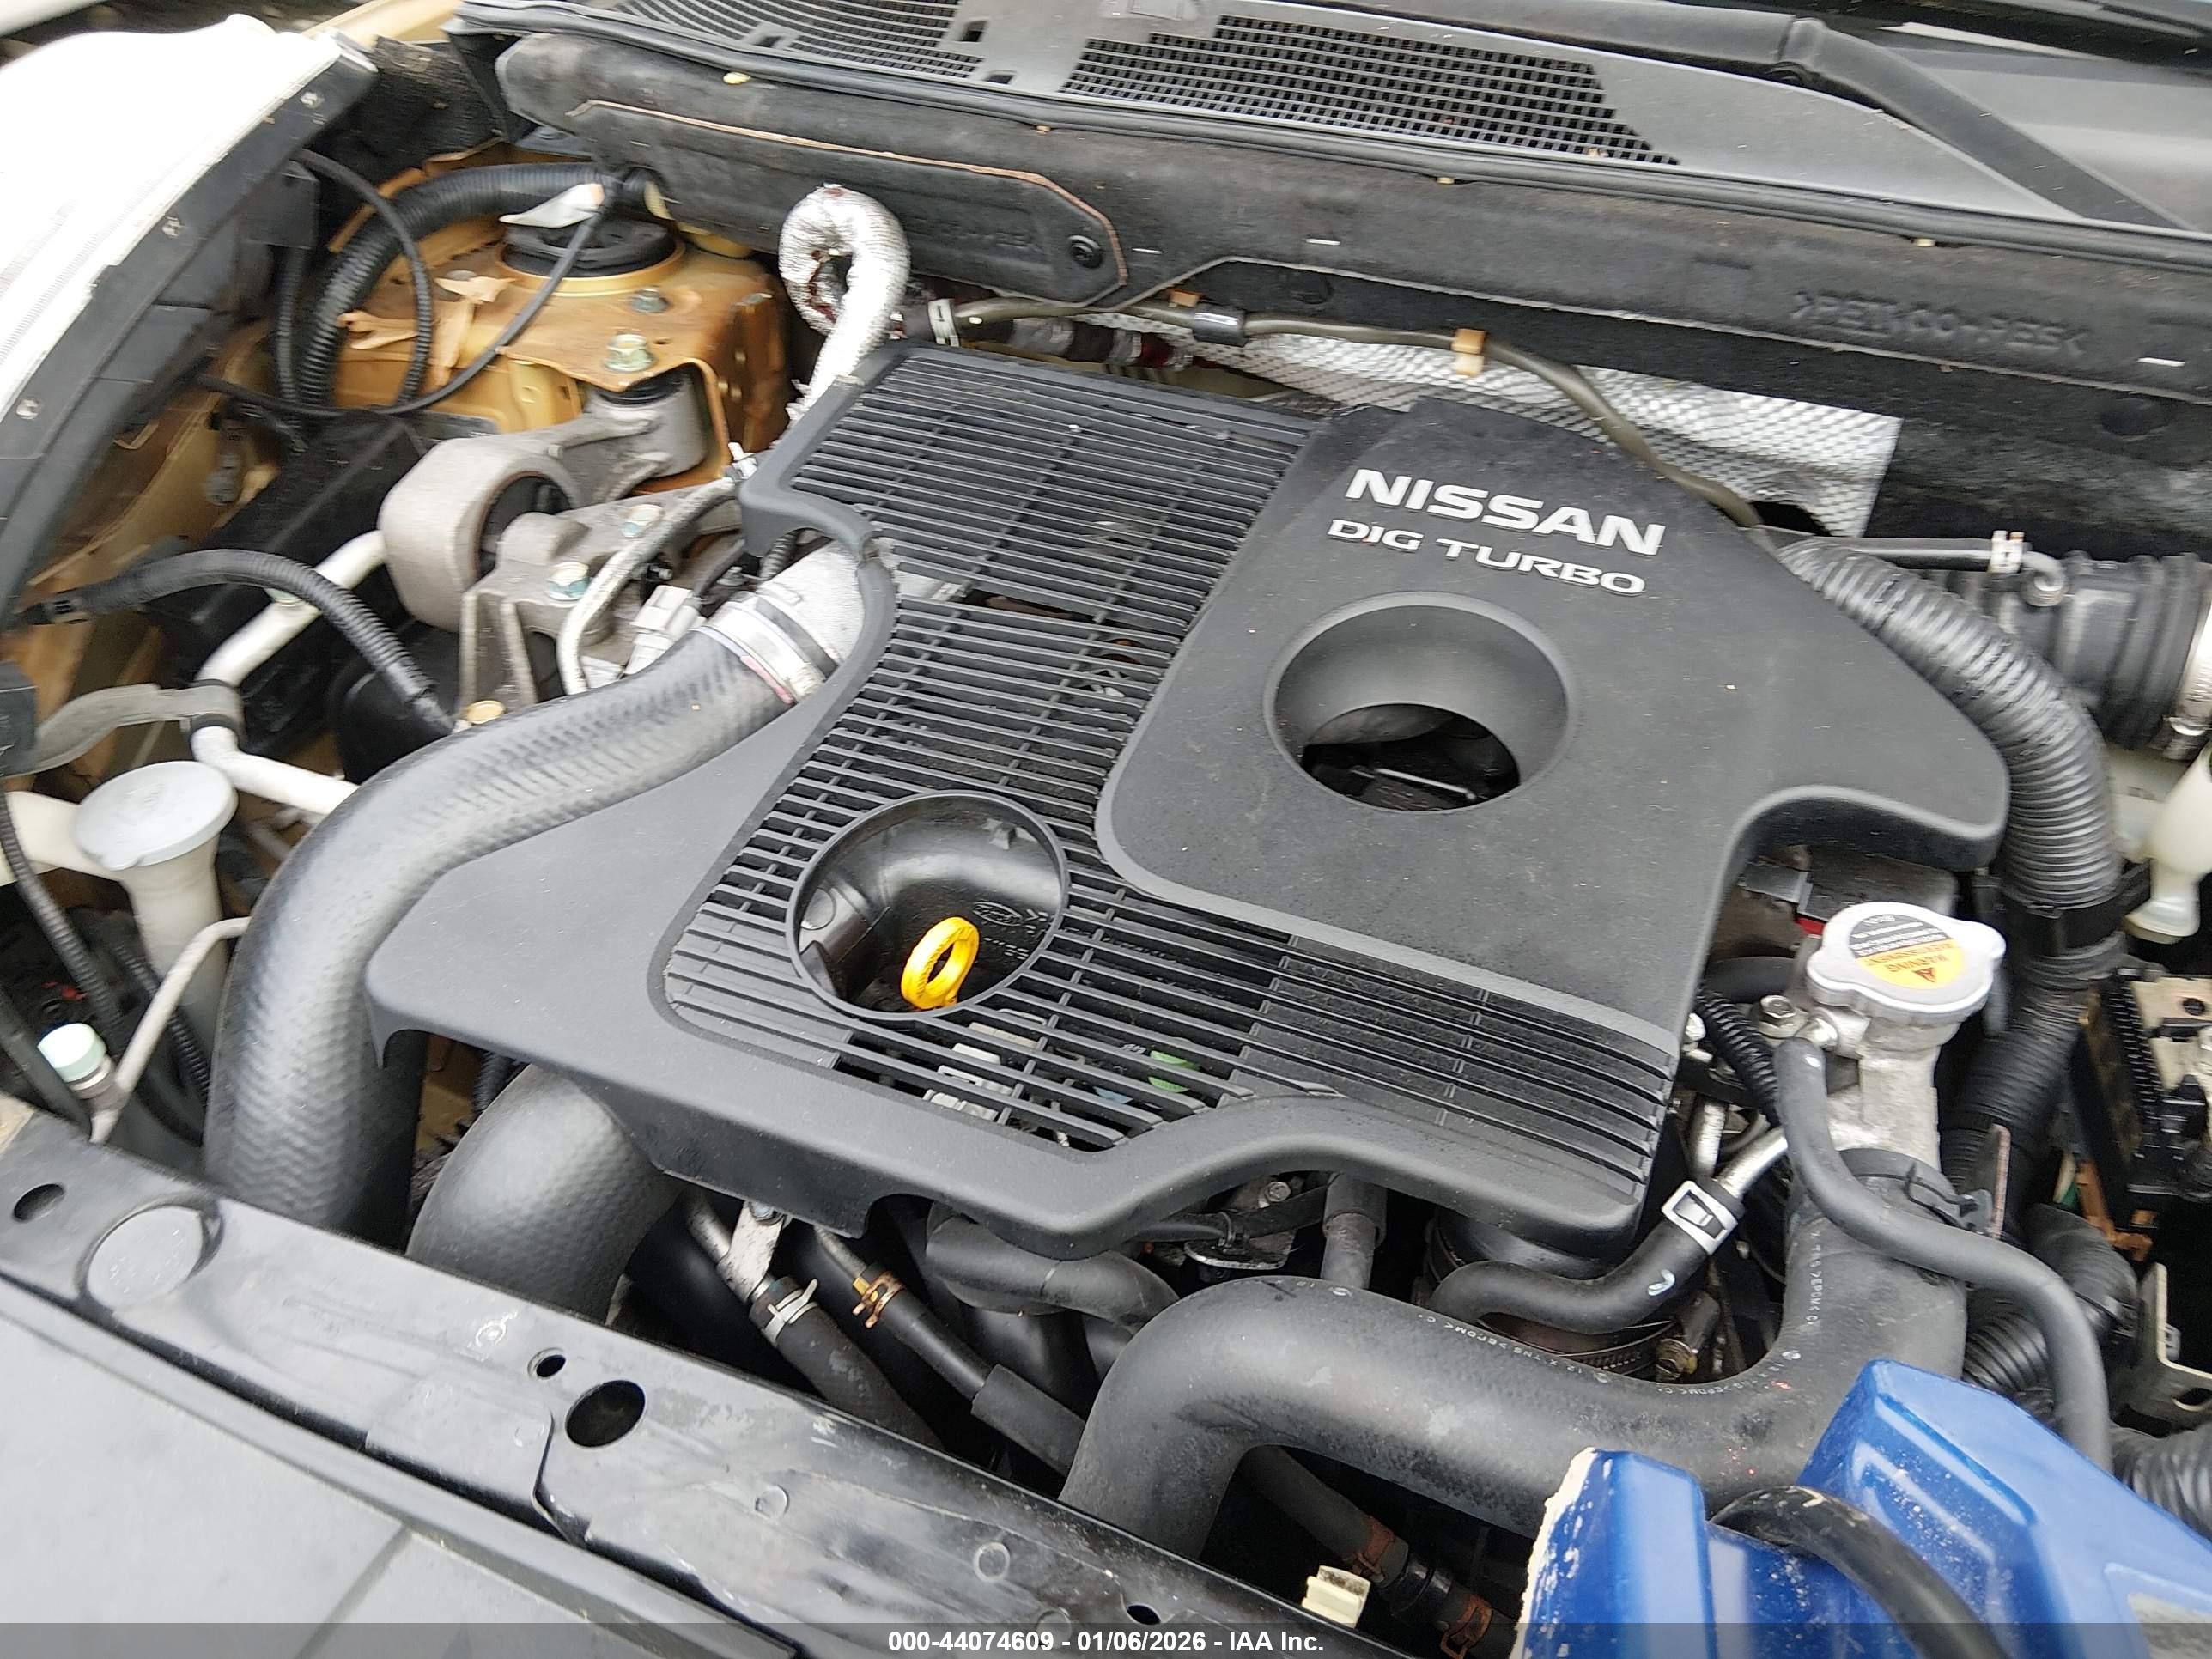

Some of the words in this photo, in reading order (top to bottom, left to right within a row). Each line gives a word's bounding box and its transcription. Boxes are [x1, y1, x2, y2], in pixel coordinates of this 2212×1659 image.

[1345, 469, 1666, 556] NISSAN
[1327, 520, 1425, 552] DIG
[1436, 538, 1646, 595] TURBO
